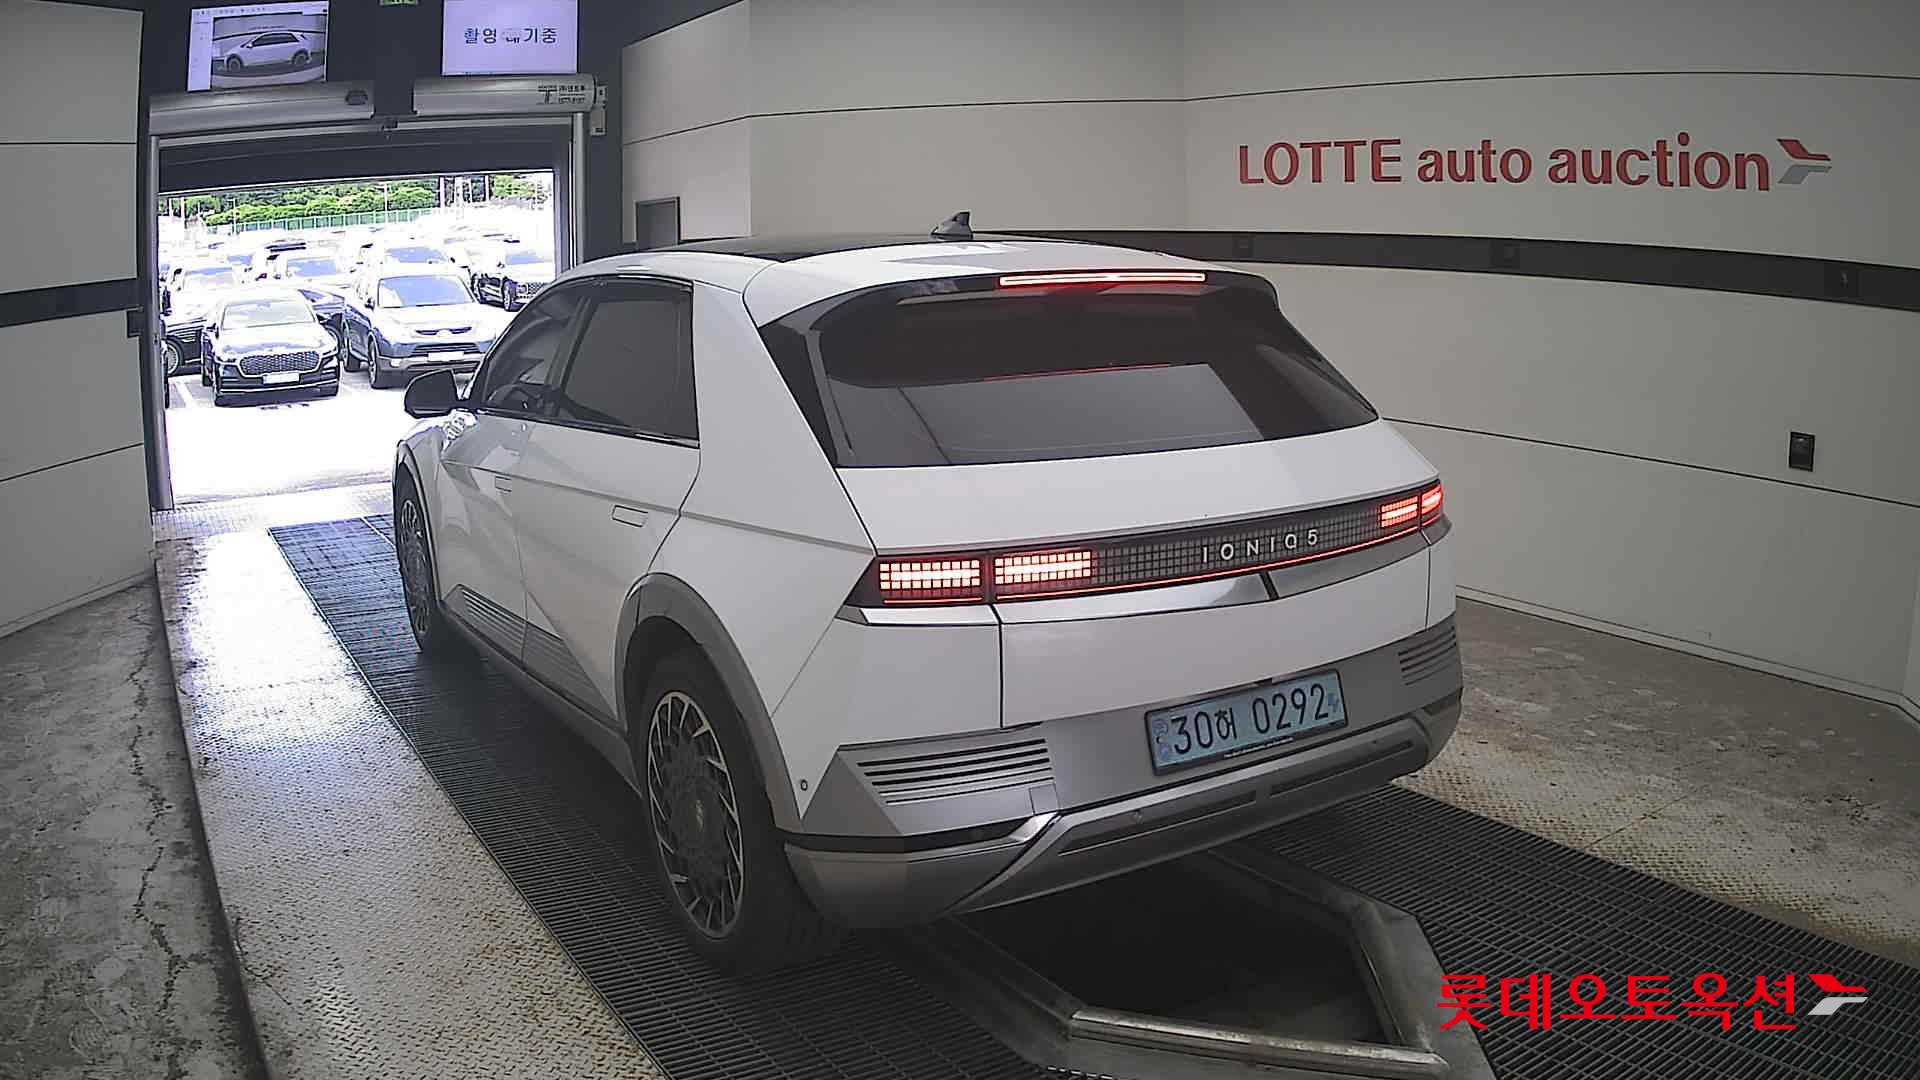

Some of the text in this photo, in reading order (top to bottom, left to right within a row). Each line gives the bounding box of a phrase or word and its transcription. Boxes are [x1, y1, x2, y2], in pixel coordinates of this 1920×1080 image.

[464, 27, 497, 44] 촬영
[1239, 132, 1770, 191] LOTTE auto auction
[1170, 707, 1238, 755] 30허
[1252, 683, 1330, 734] 0292
